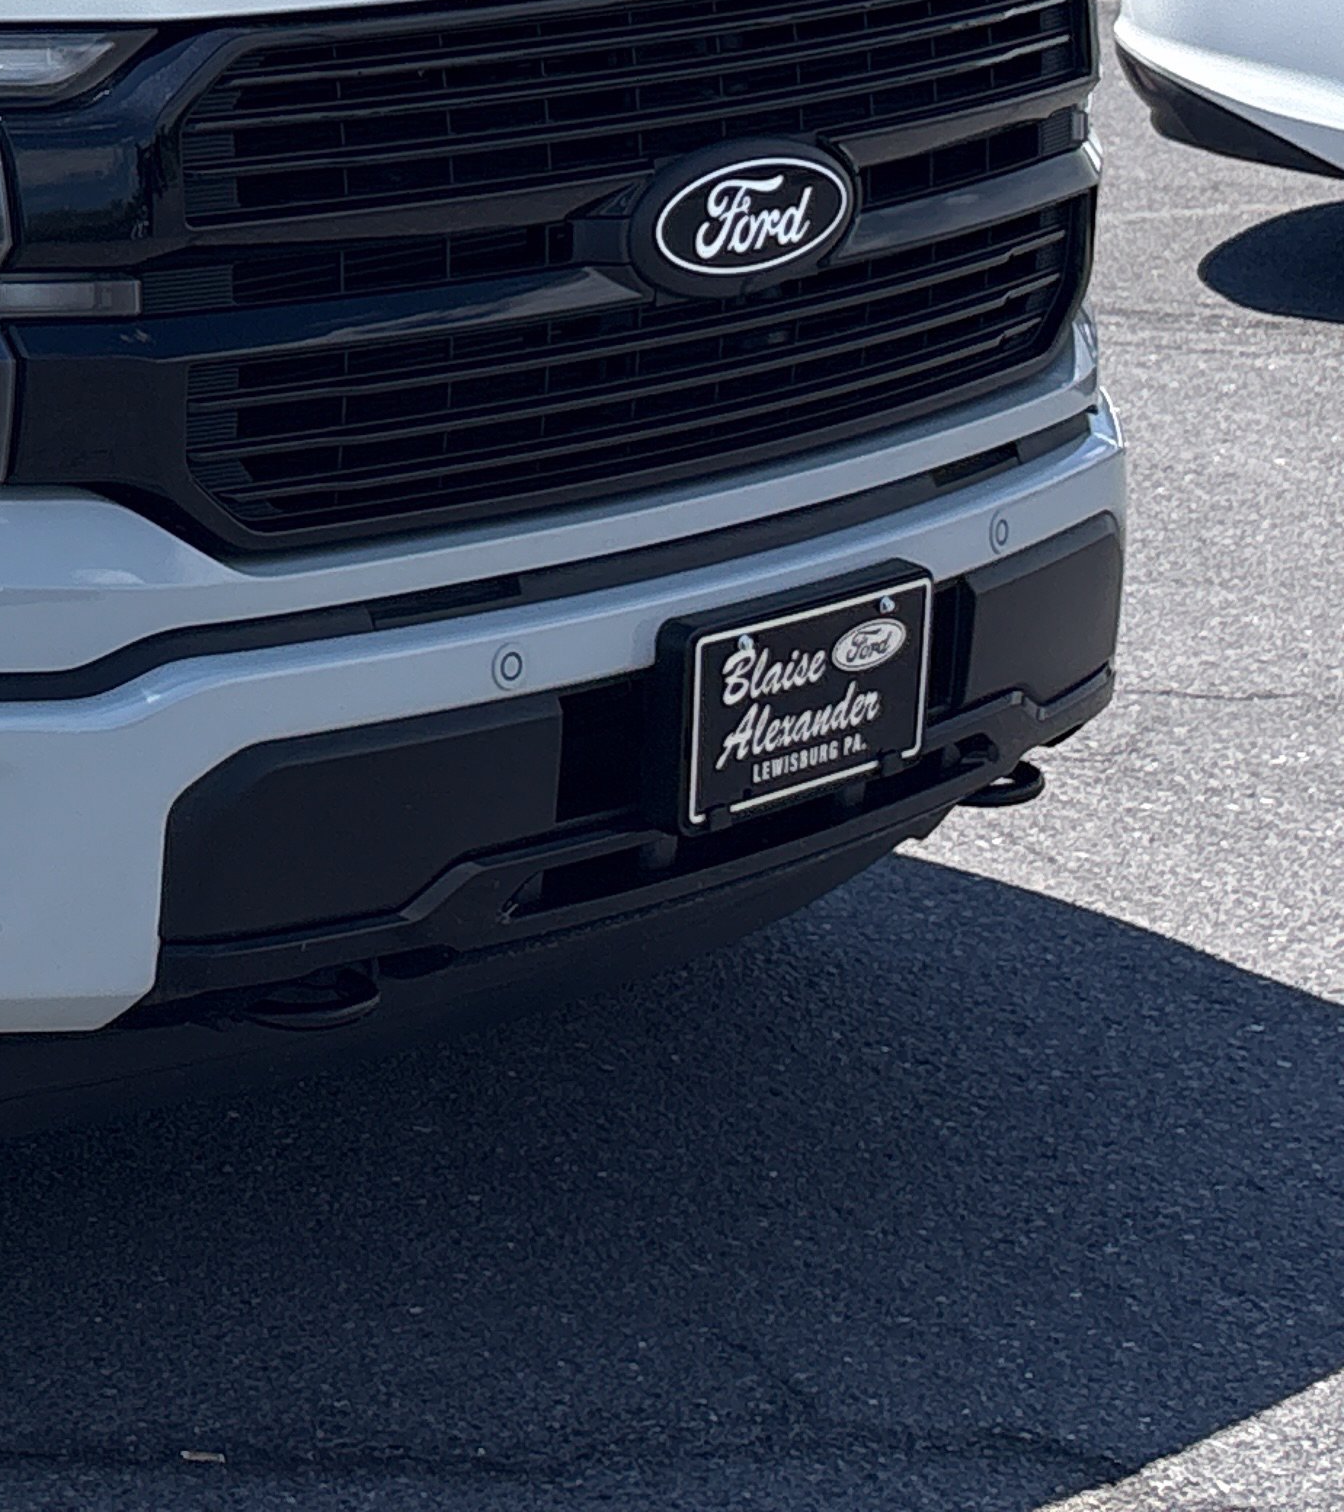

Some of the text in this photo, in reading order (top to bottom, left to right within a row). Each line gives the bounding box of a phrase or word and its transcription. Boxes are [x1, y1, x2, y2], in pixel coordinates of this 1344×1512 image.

[694, 174, 814, 259] Ford
[845, 627, 895, 662] Ford
[722, 648, 826, 706] Blaise
[715, 680, 881, 770] Alexander
[752, 733, 868, 784] LEWISBURG PA.
